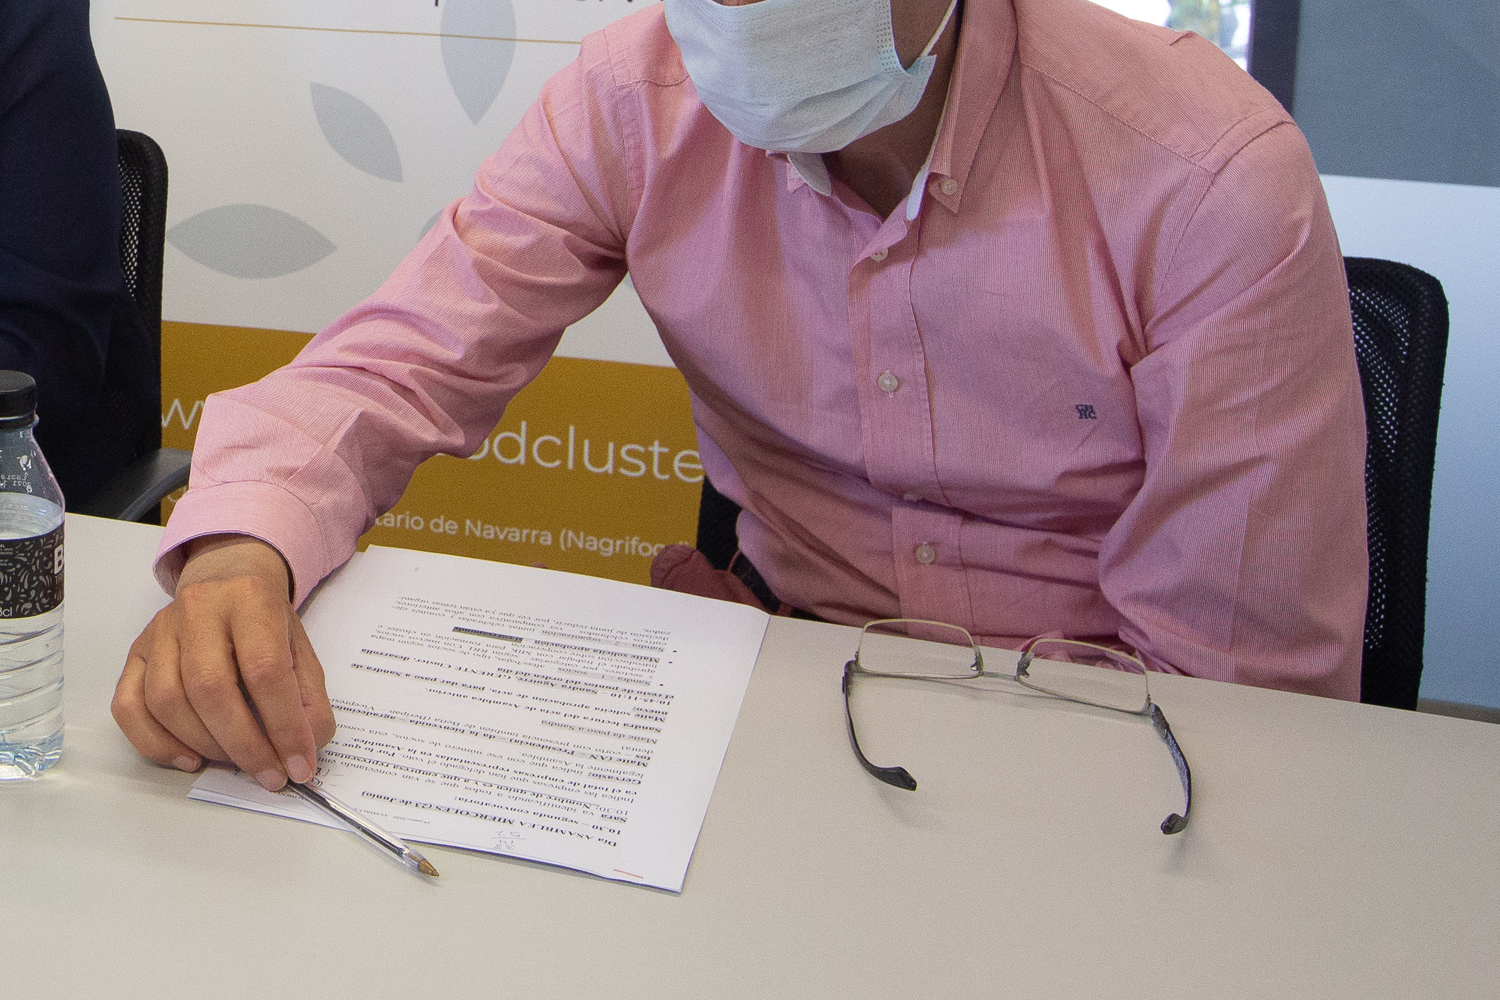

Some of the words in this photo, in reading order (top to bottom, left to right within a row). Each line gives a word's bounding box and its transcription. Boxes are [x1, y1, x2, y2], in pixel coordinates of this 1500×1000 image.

[429, 515, 459, 536] de
[465, 519, 553, 546] Navarra
[433, 804, 515, 825] MIERCOLES
[516, 820, 594, 840] ASAMBLEA
